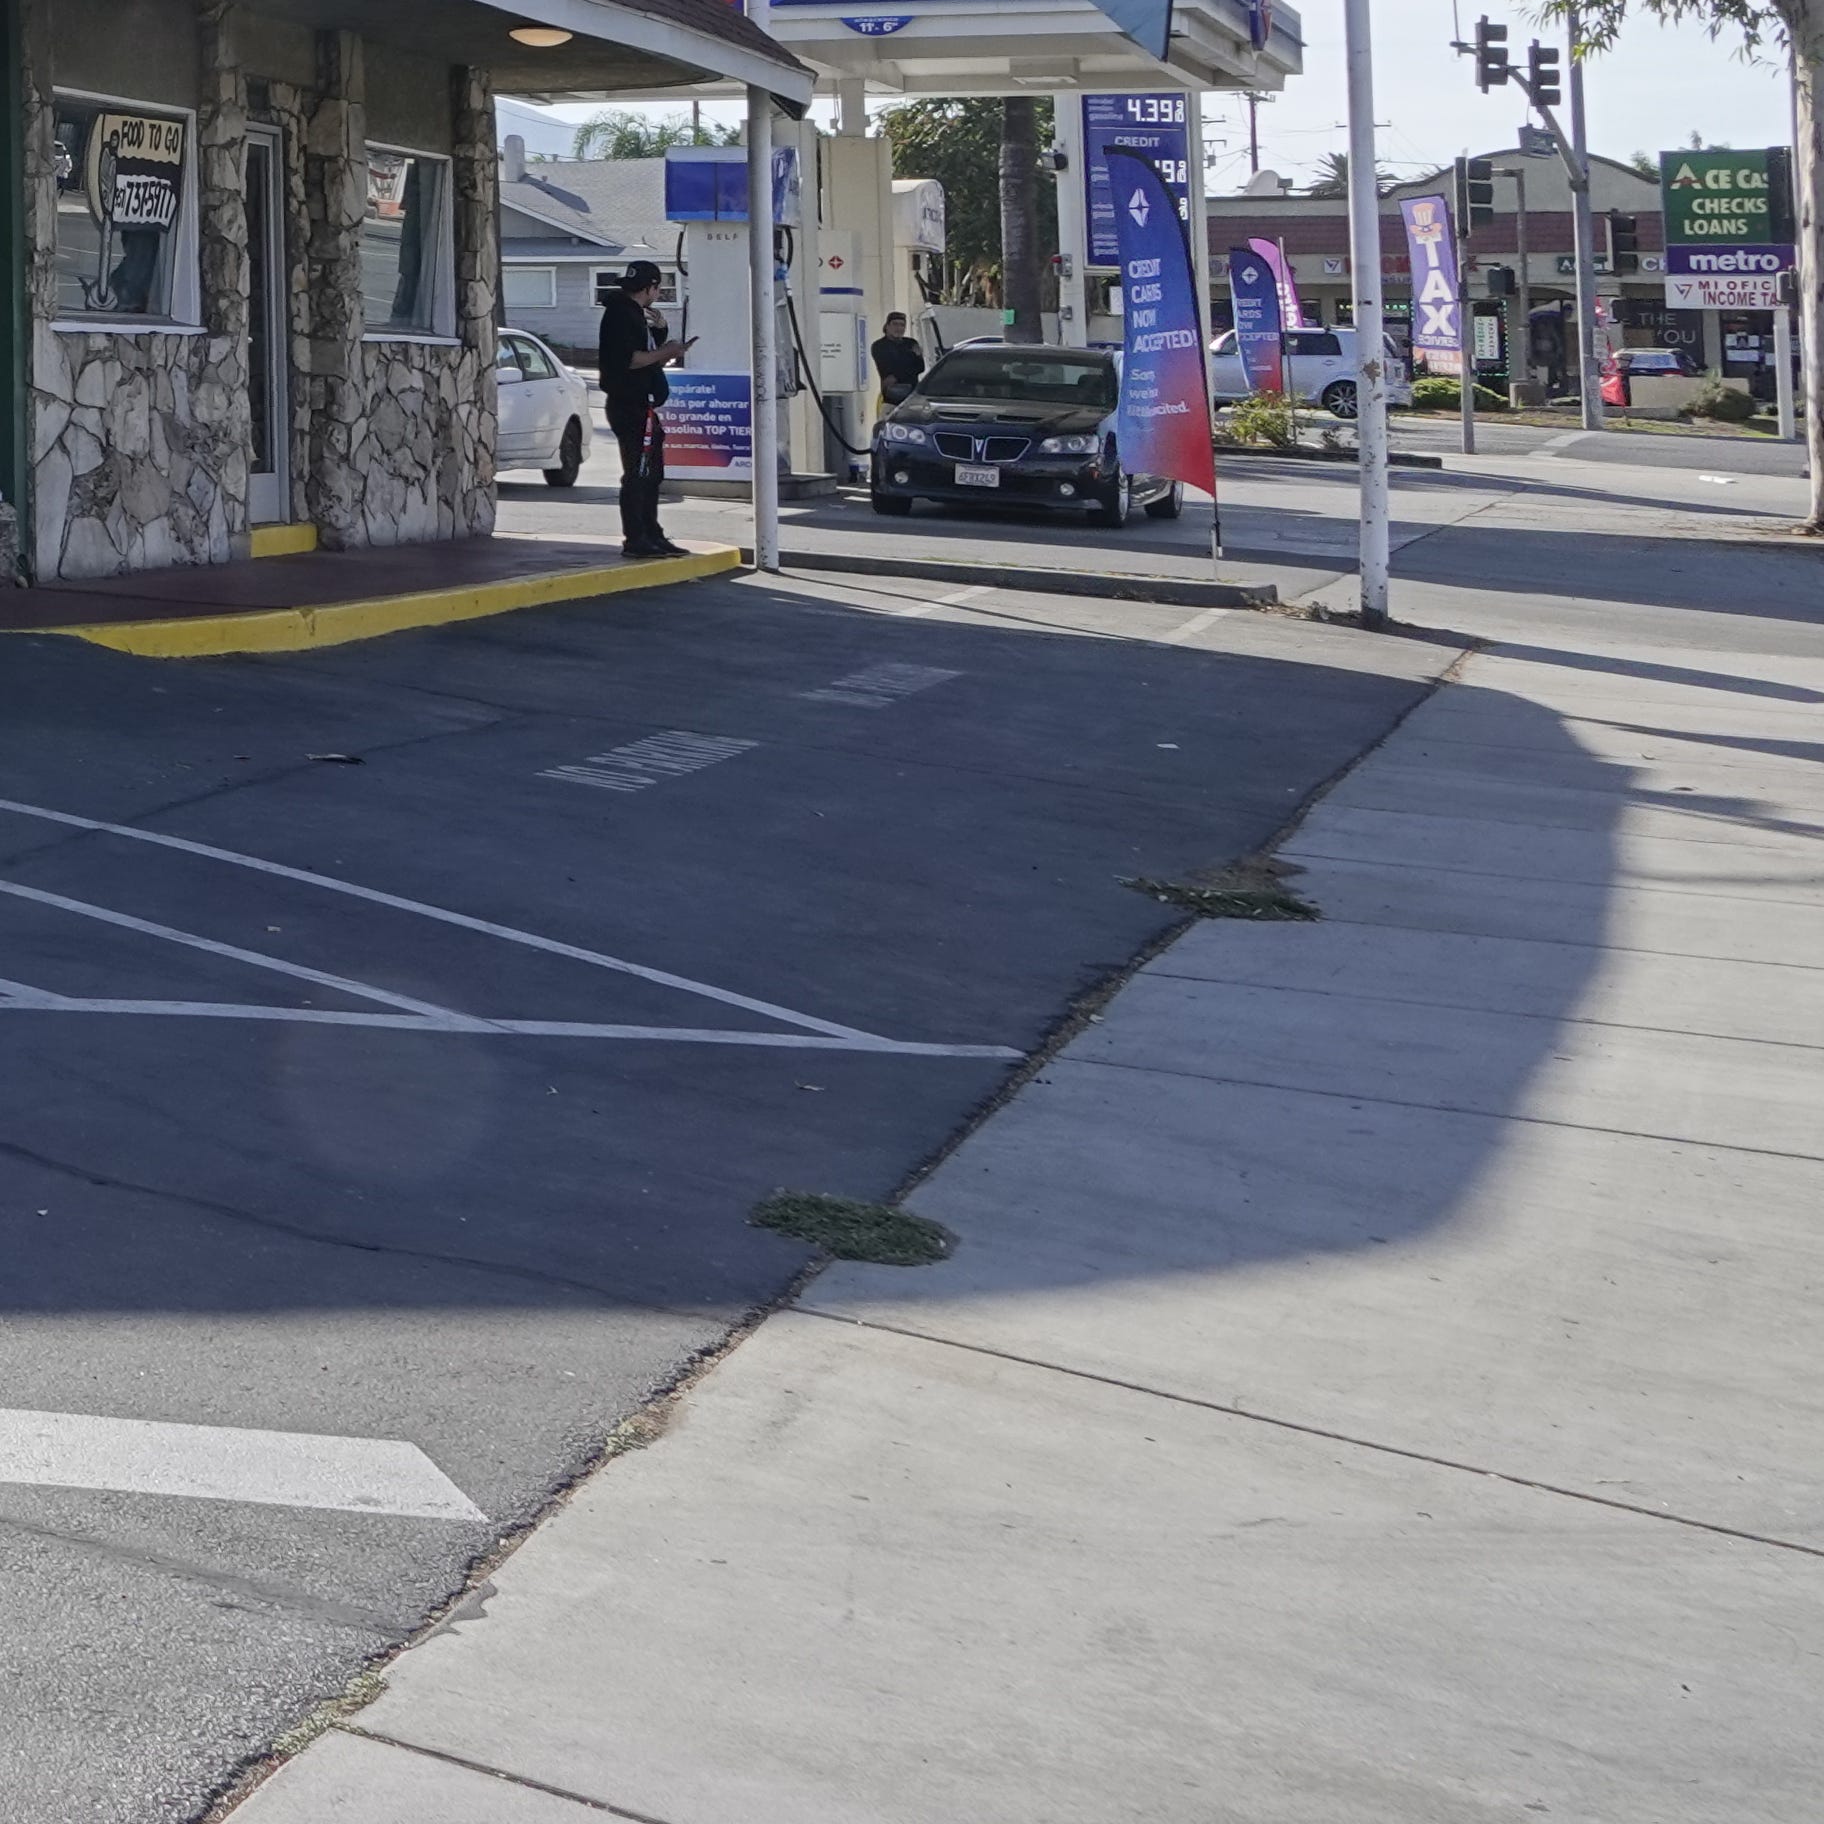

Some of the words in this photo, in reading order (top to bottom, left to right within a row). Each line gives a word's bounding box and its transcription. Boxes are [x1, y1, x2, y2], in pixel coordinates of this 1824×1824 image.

[120, 120, 145, 150] FOOD
[149, 123, 162, 152] TO
[165, 126, 180, 156] GO
[1114, 136, 1161, 147] CREDIT
[1670, 162, 1733, 190] ACE
[1691, 197, 1769, 215] CHECKS
[1683, 218, 1749, 236] LOANS
[1688, 249, 1781, 272] metro
[1698, 280, 1718, 290] MI
[1703, 291, 1757, 307] INCOME
[1657, 328, 1697, 345] OU
[663, 424, 703, 435] asolina
[704, 425, 727, 435] TOP
[735, 460, 752, 468] ARC
